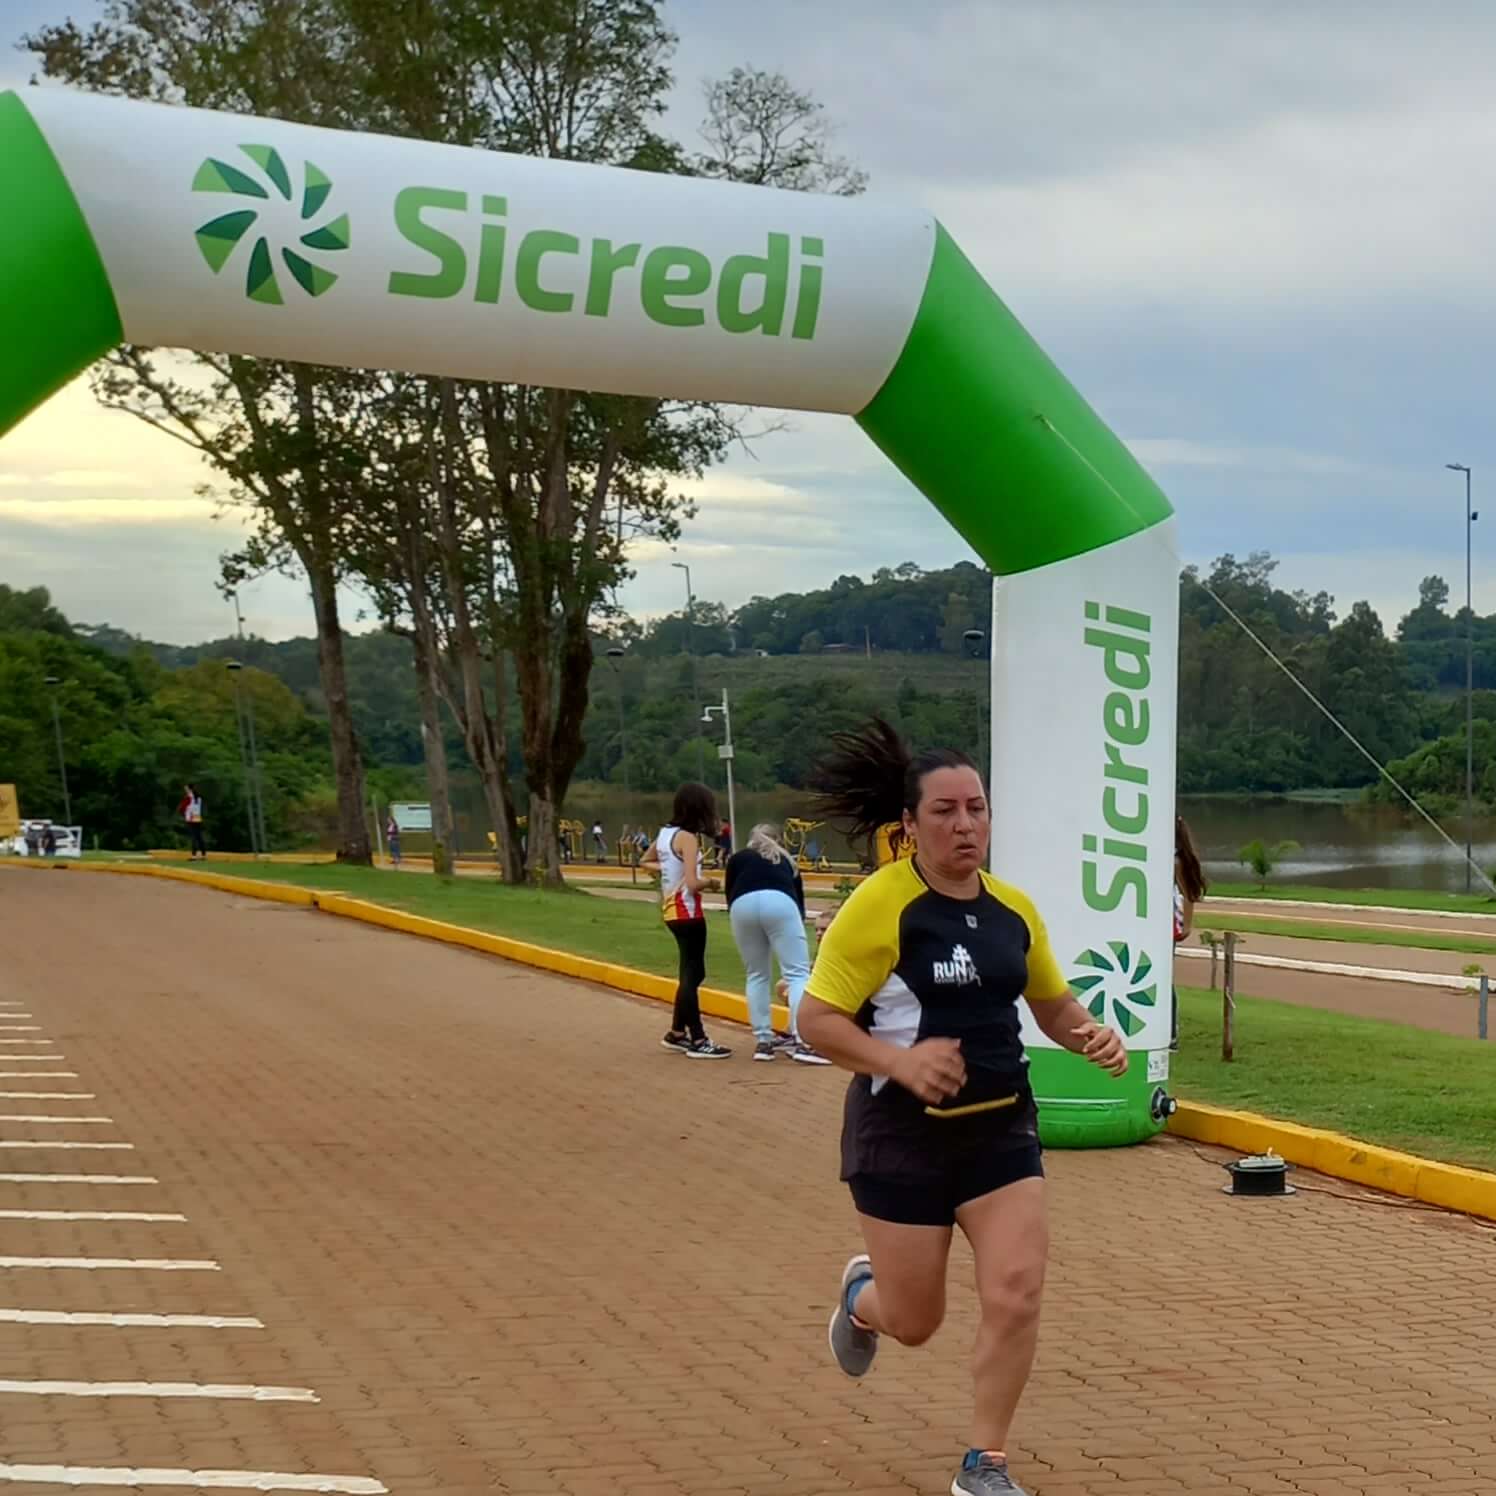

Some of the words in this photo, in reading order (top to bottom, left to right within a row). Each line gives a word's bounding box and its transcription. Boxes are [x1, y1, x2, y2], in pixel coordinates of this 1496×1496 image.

[387, 186, 824, 340] Sicredi
[1082, 600, 1151, 919] Sicredi
[933, 961, 967, 978] RUN
